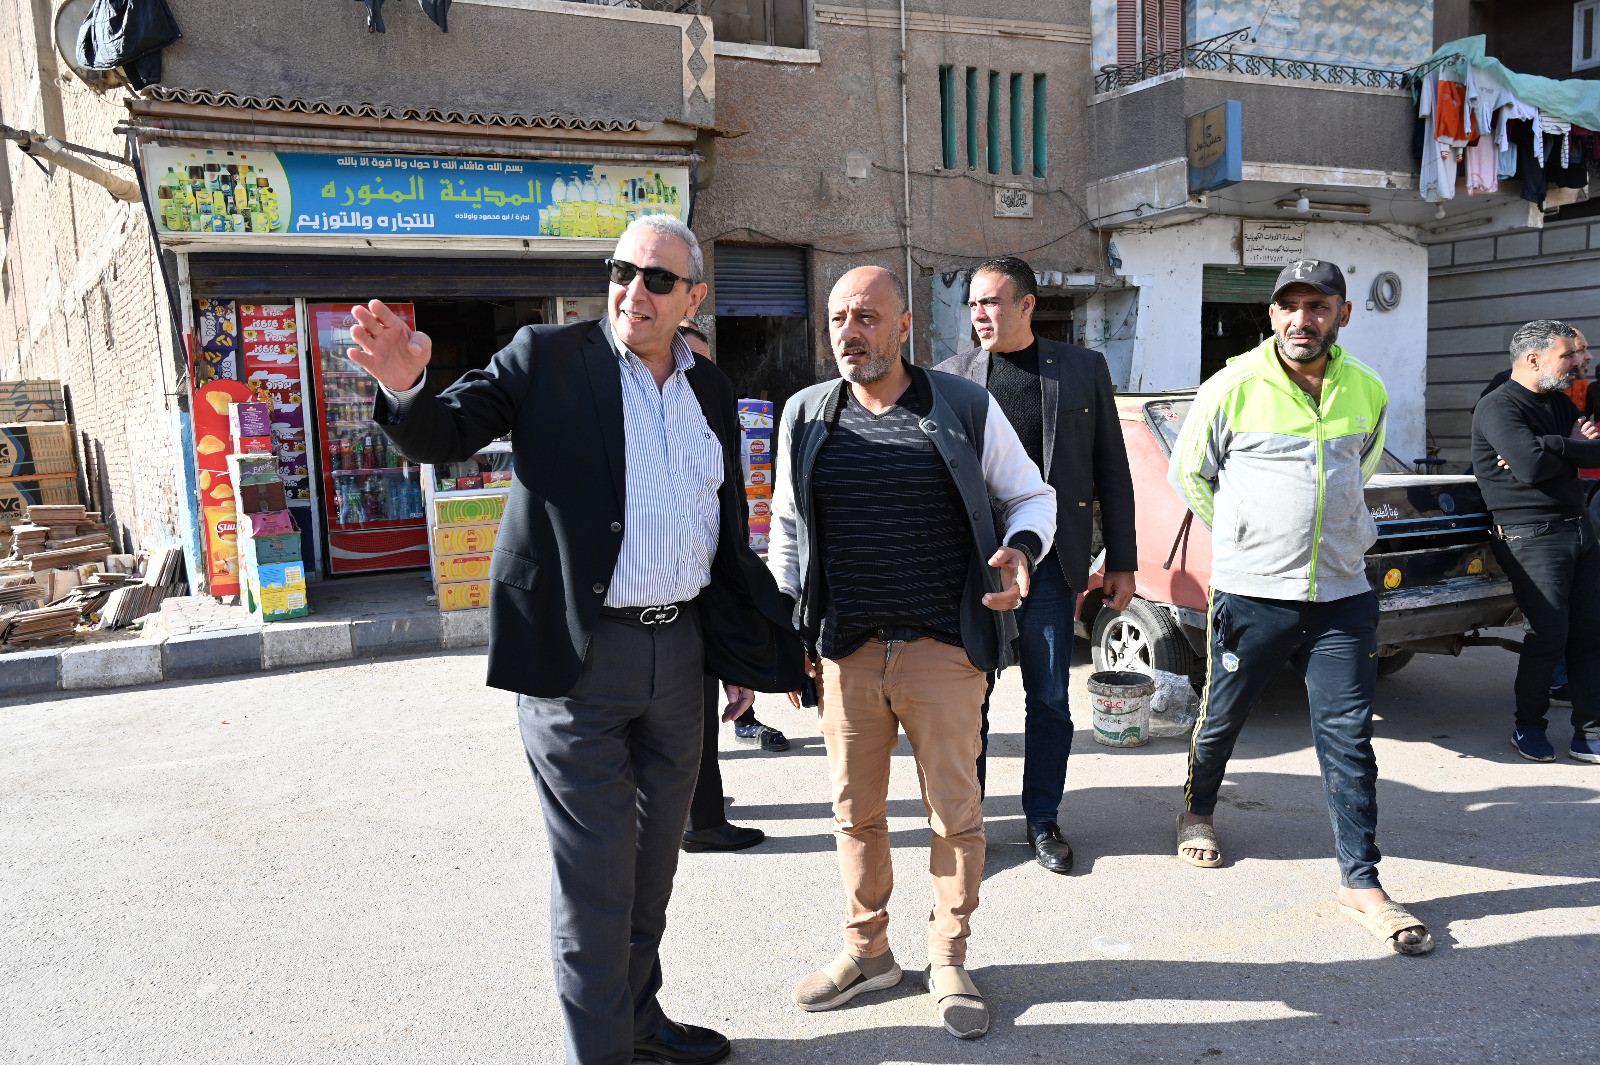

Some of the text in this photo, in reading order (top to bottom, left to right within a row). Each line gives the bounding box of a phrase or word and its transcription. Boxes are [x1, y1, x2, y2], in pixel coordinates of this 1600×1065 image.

[336, 156, 524, 174] بسم الله ماشاء الله لا حول ولا قوة الا بالله
[321, 174, 542, 209] المدينة المنوره
[296, 211, 435, 231] للتجاره والتوزيع
[1103, 699, 1123, 709] GLC
